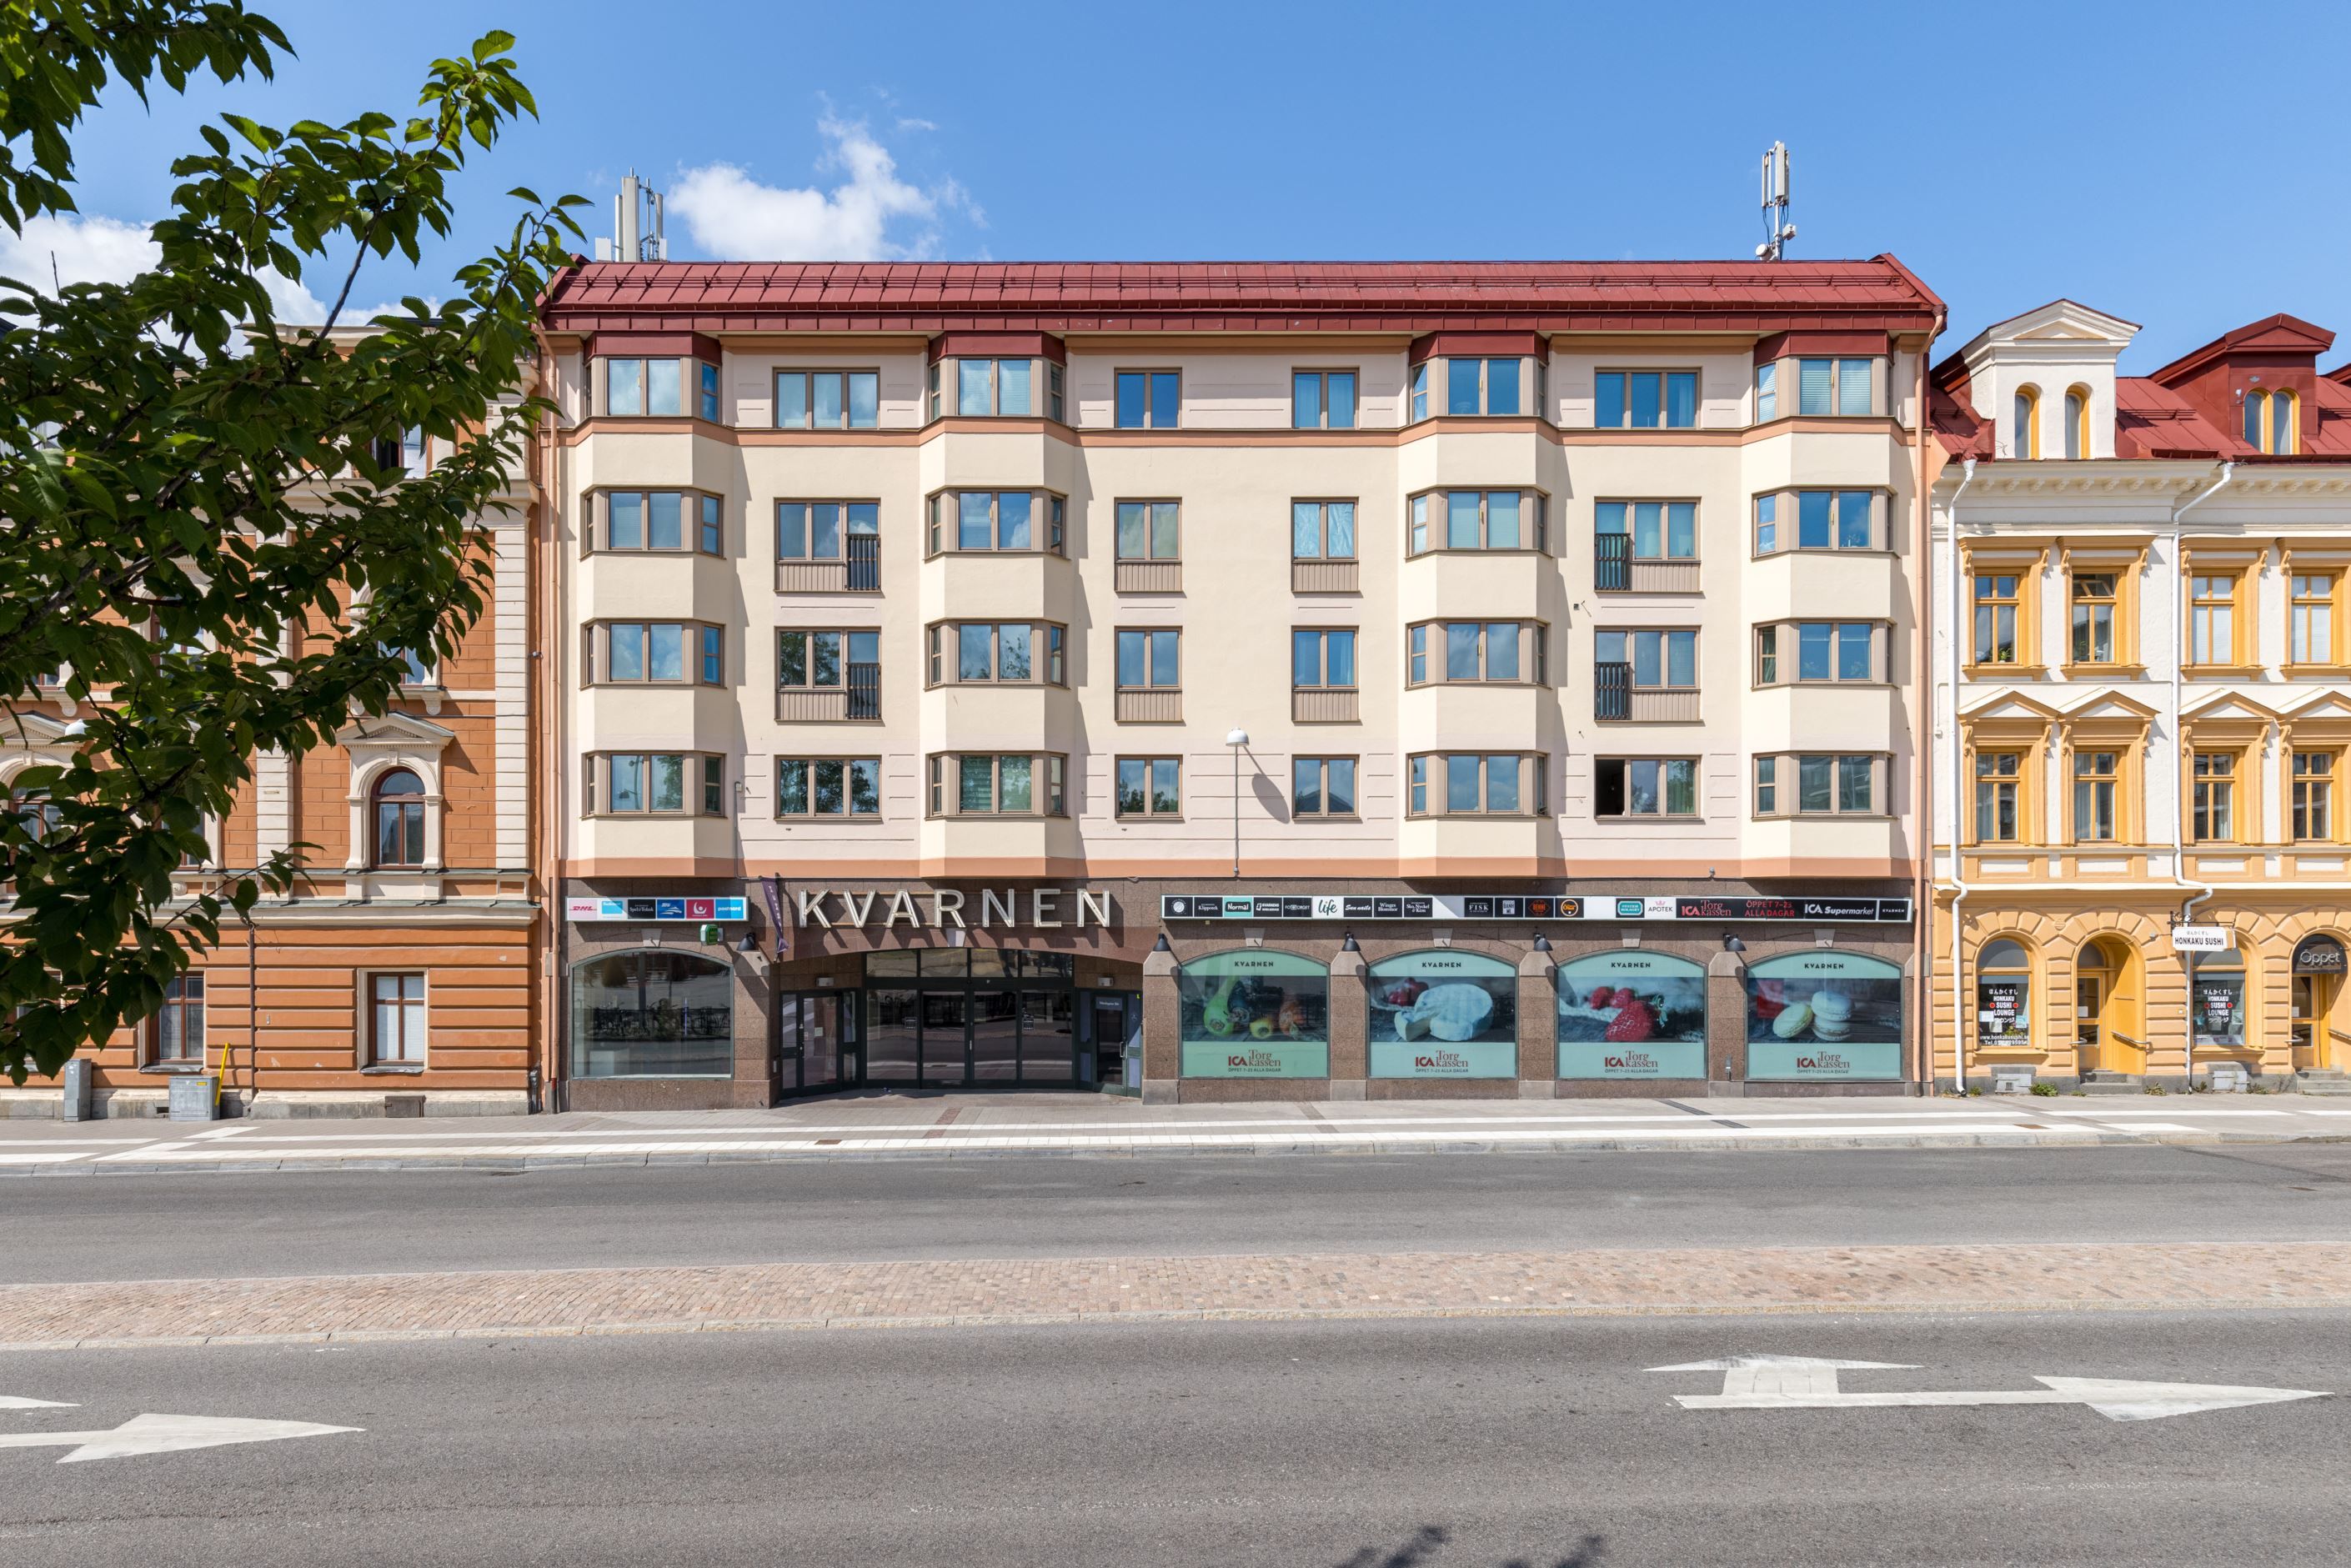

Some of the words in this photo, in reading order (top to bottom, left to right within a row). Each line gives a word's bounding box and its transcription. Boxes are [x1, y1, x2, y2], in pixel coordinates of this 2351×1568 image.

[799, 888, 1110, 928] KVARNEN
[1227, 903, 1249, 911] Normal
[1318, 899, 1337, 916] life
[1701, 899, 1723, 911] Torg
[1746, 899, 1772, 908] ÖPPET
[1681, 905, 1700, 916] ICA
[1701, 906, 1732, 916] kassen
[1804, 904, 1822, 914] ICA
[1824, 906, 1874, 915] Supermarket
[2174, 937, 2203, 945] HONKAKU
[2300, 949, 2341, 966] Öppet
[1249, 1050, 1272, 1060] Torg
[1436, 1050, 1460, 1061] Torg
[1626, 1050, 1649, 1061] Torg
[1817, 1051, 1841, 1062] Torg
[1228, 1055, 1248, 1066] ICA
[1249, 1056, 1281, 1066] kassen
[1415, 1056, 1435, 1067] ICA
[1436, 1057, 1468, 1067] kassen
[1605, 1057, 1625, 1067] ICA
[1626, 1057, 1658, 1067] kassen
[1797, 1058, 1817, 1068] ICA
[1817, 1058, 1850, 1068] kassen
